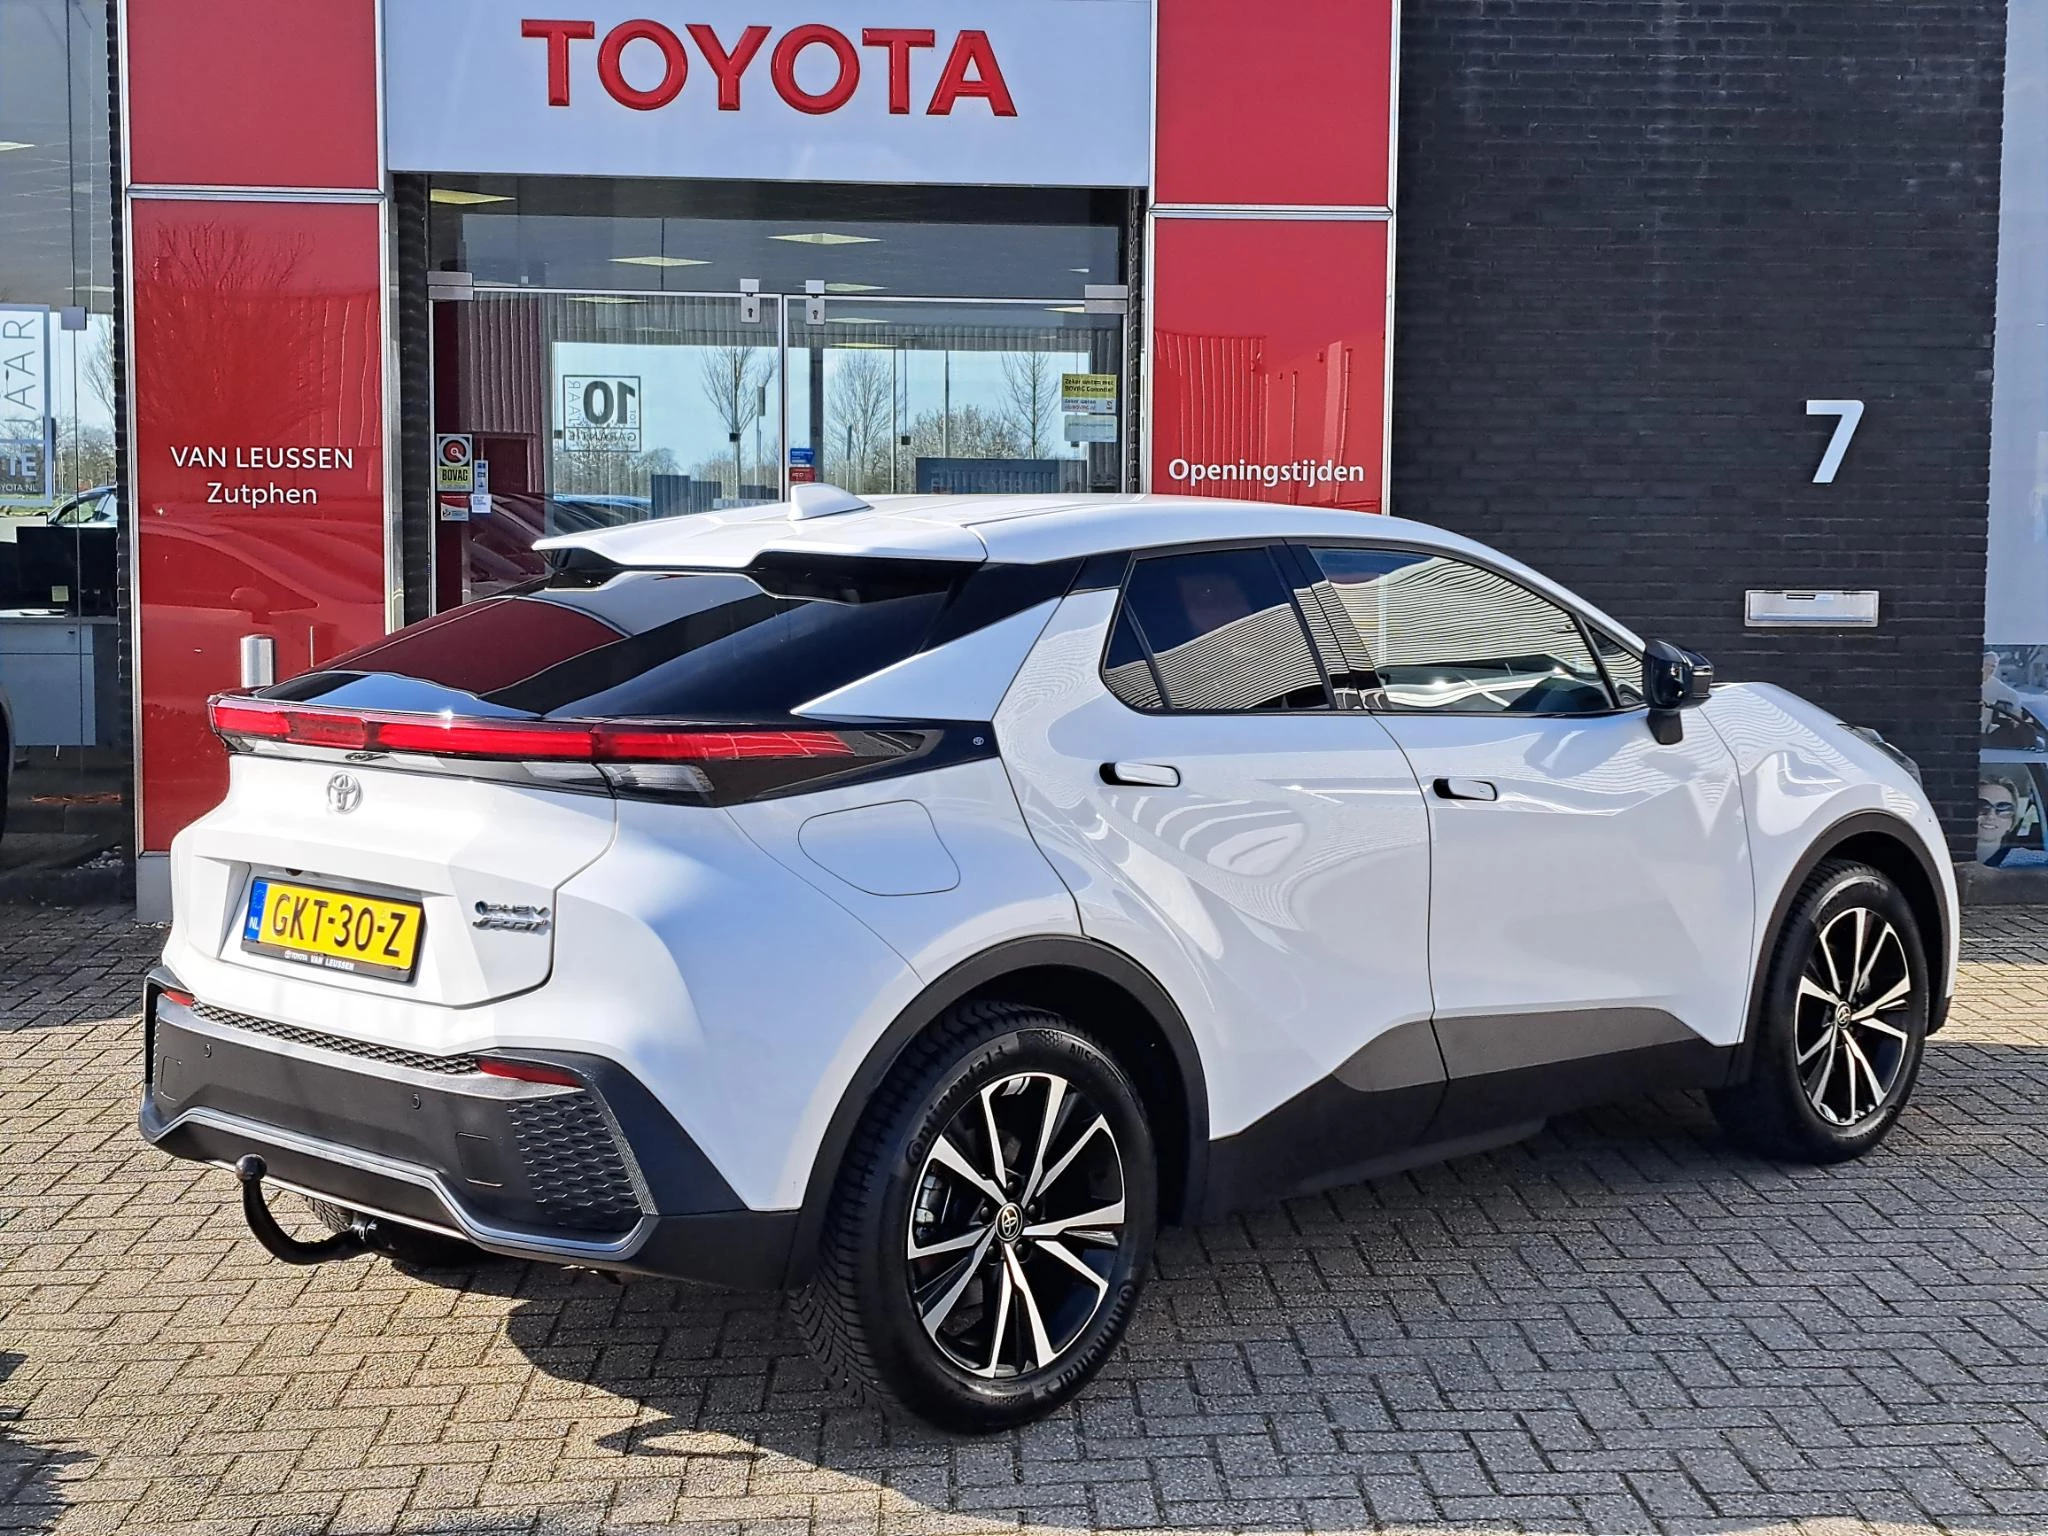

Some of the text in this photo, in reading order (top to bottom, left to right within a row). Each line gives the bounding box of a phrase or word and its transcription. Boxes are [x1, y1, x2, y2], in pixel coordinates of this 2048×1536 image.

[521, 18, 1018, 117] TOYOTA
[1805, 399, 1865, 484] 7
[170, 446, 353, 470] VAN LEUSSEN
[1168, 458, 1365, 488] Openingstijden
[206, 482, 318, 510] Zutphen
[248, 915, 260, 930] NL
[272, 893, 408, 958] GKT-30-Z
[310, 954, 324, 965] VAN
